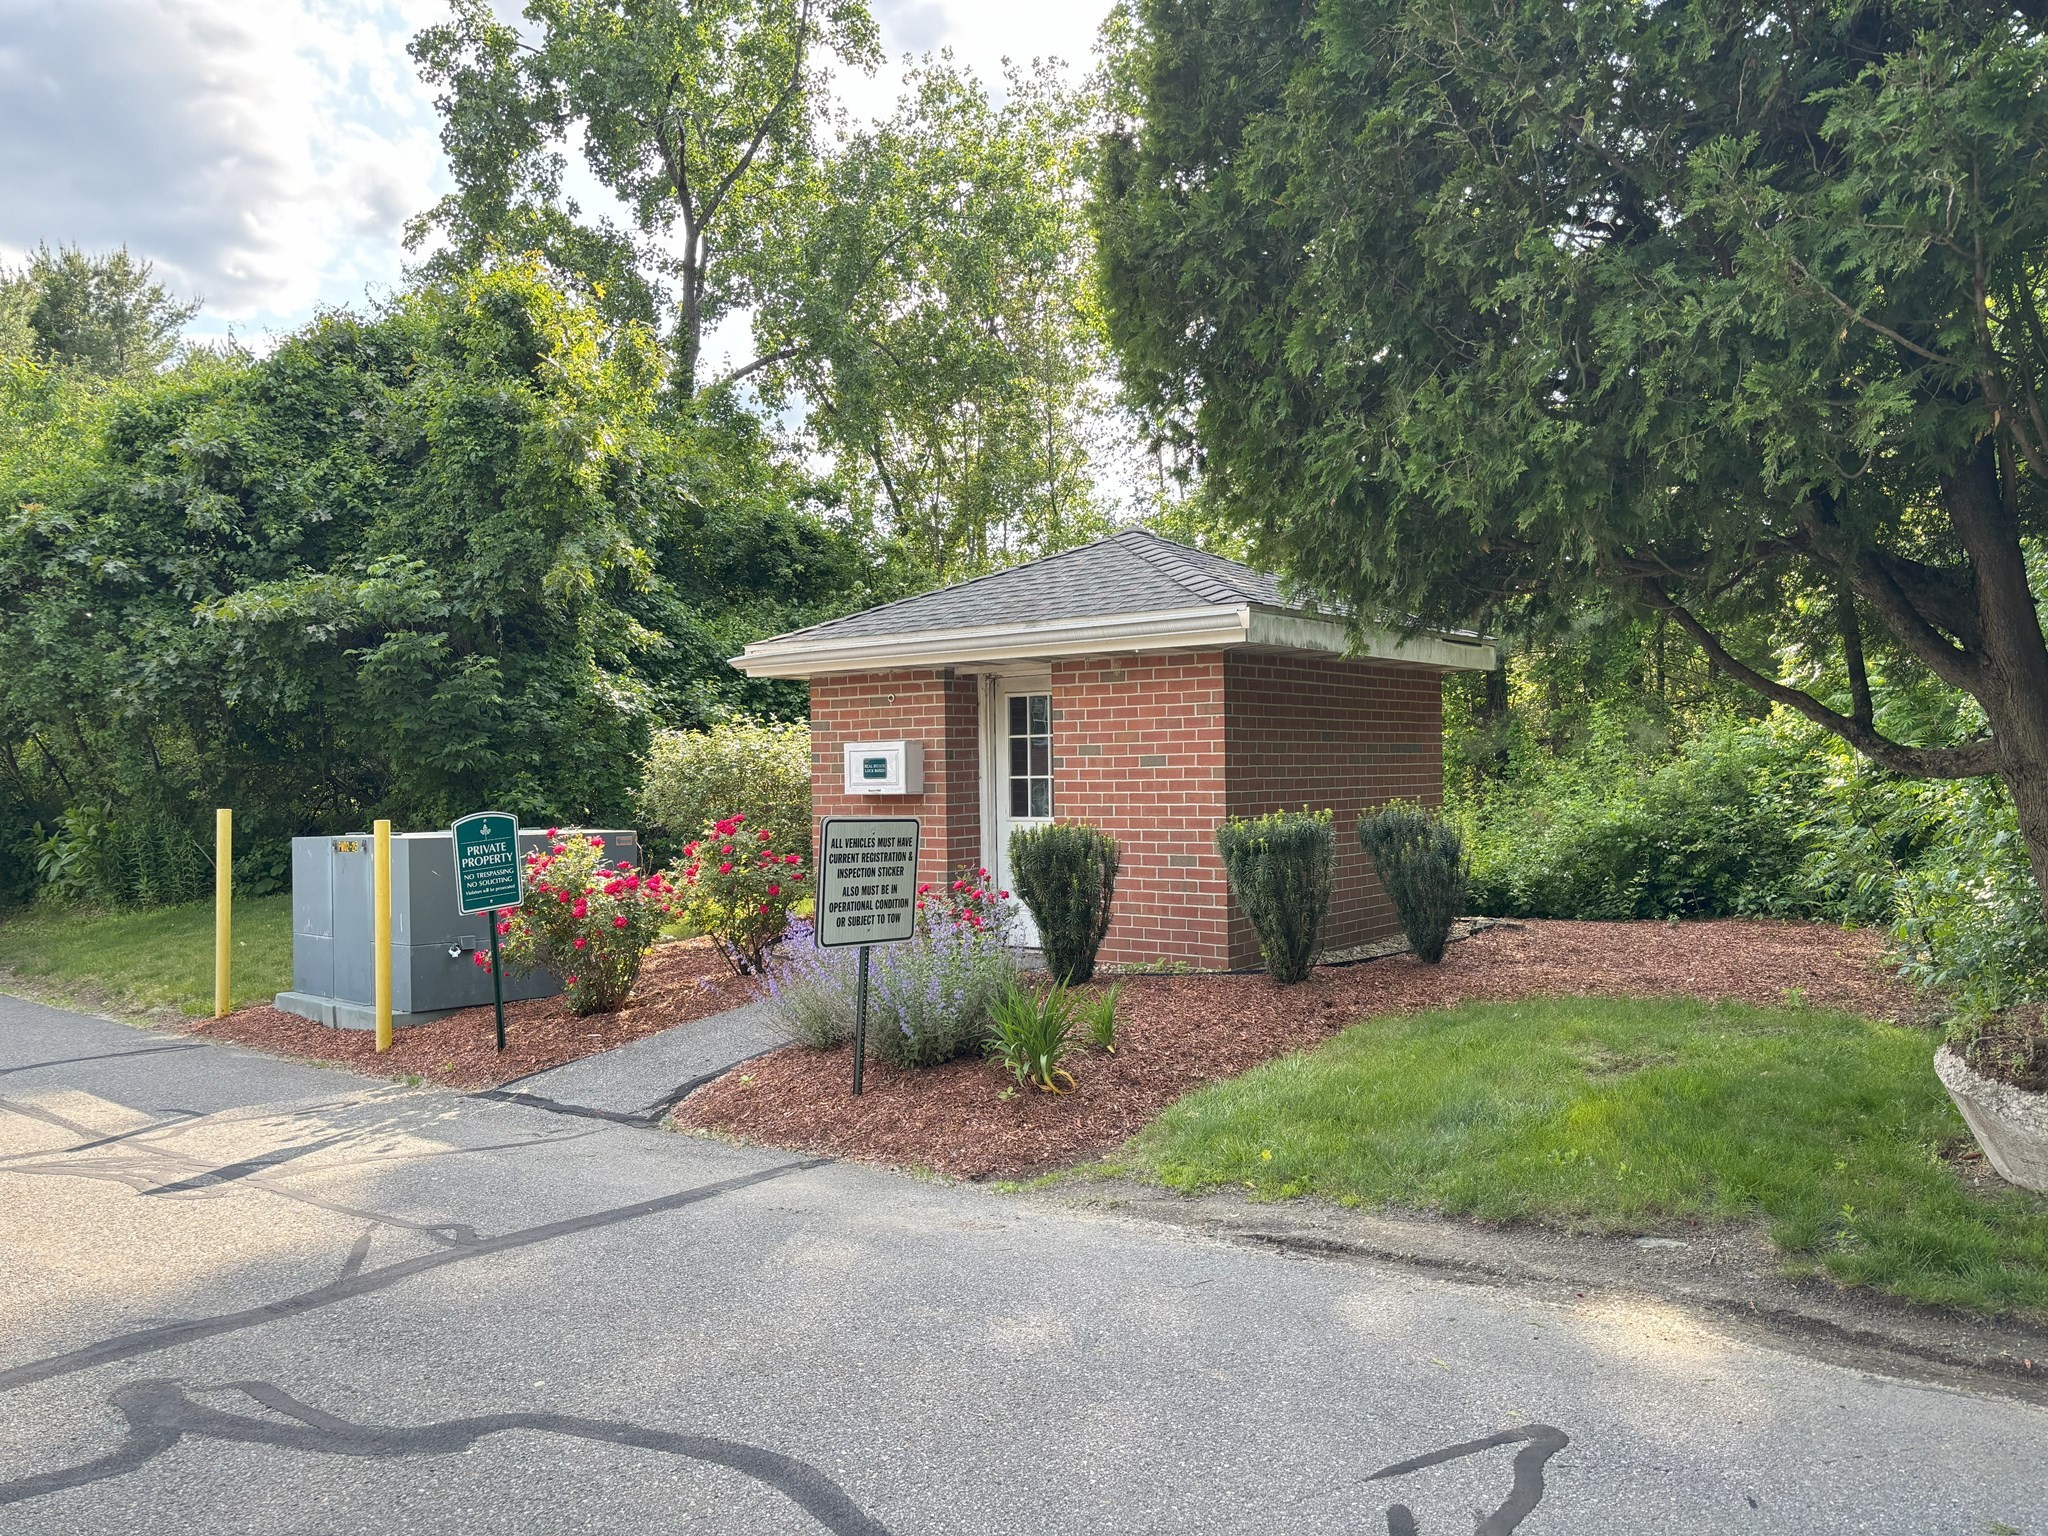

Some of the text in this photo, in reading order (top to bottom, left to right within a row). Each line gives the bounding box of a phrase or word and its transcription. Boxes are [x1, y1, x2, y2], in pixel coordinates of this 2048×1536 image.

[467, 842, 507, 856] PRIVATE
[830, 837, 912, 849] ALL VEHICLES MUST HAVE
[462, 852, 513, 868] PROPERTY
[829, 852, 913, 864] CURRENT REGISTRATION &
[476, 868, 514, 878] TRESPASSING
[837, 866, 904, 879] INSPECTION STICKER
[479, 876, 512, 886] SOLICITING
[842, 884, 898, 897] ALSO MUST BE IN
[829, 898, 909, 913] OPERATIONAL CONDITION
[836, 913, 901, 927] OR SUBJECT TO TOW
